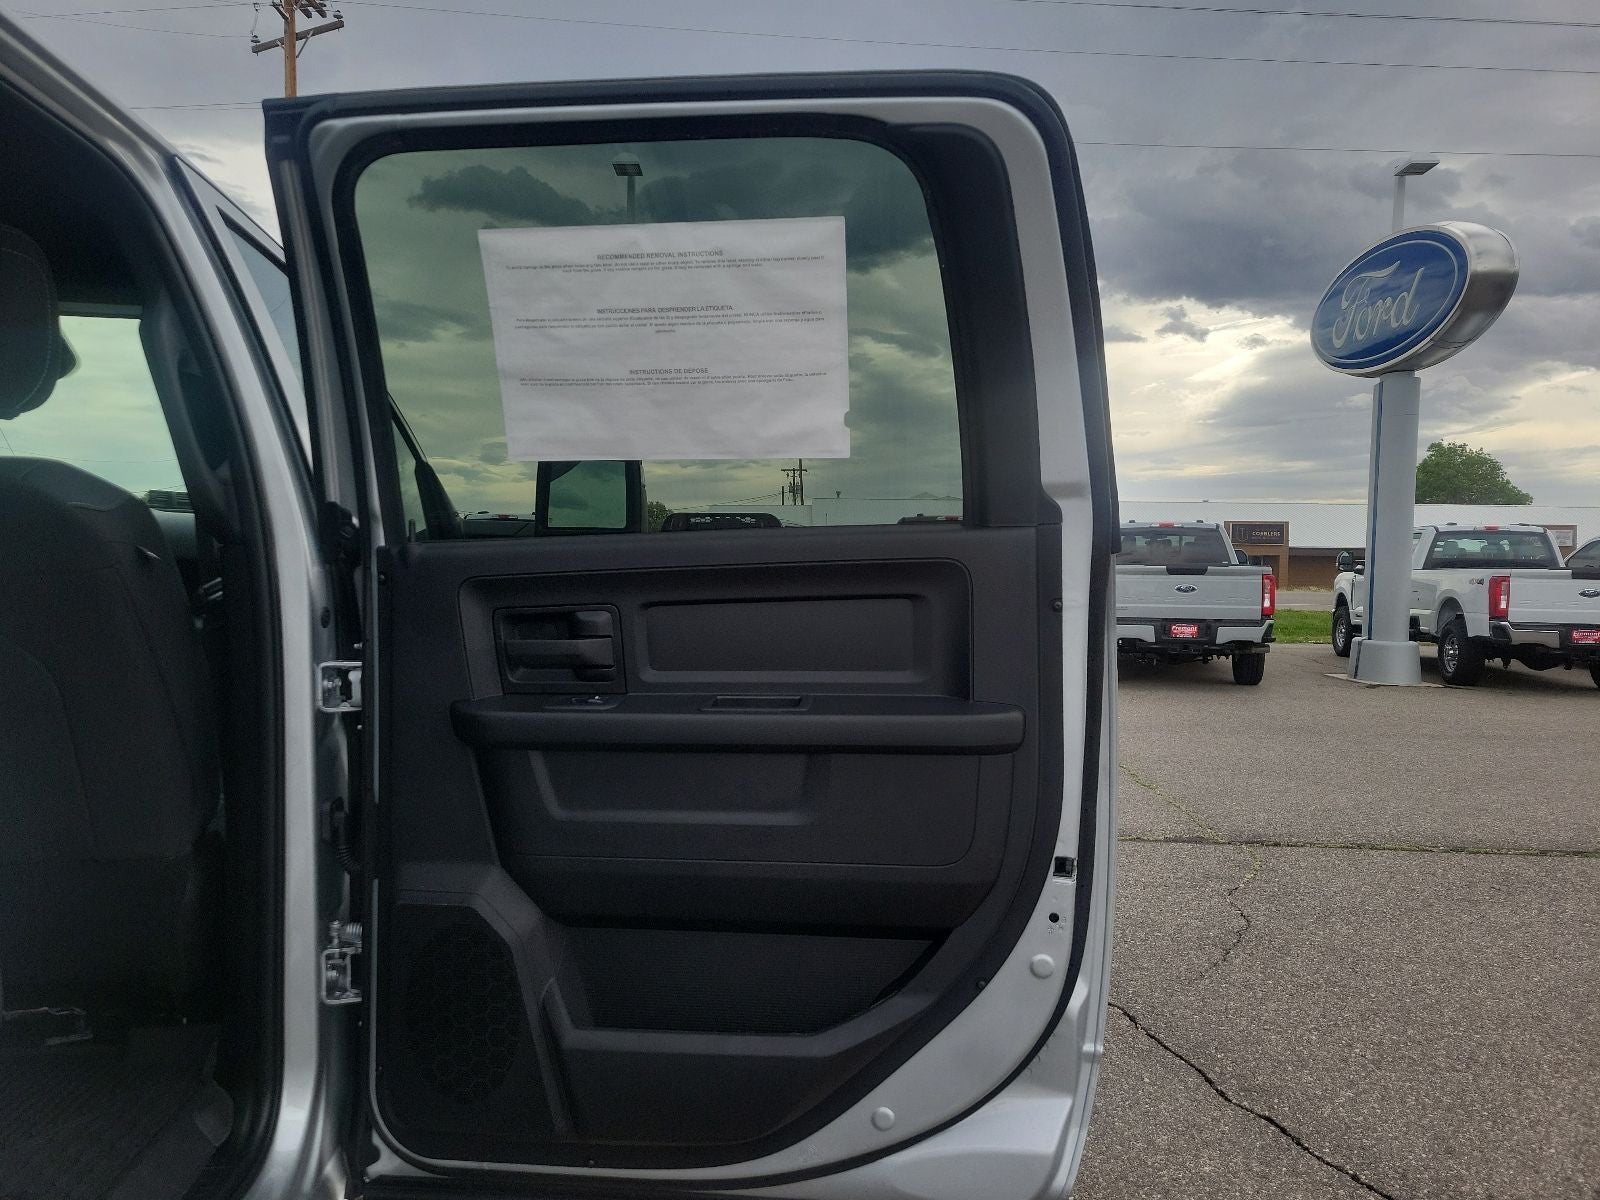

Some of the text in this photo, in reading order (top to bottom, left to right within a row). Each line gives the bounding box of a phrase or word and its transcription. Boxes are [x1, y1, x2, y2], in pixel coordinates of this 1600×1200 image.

[597, 249, 723, 261] RECOMMENDED REMOVAL INSTRUCTIONS
[706, 304, 733, 312] ETIQUETA
[1332, 260, 1425, 349] Ford
[629, 368, 673, 376] INSTRUCTIONS
